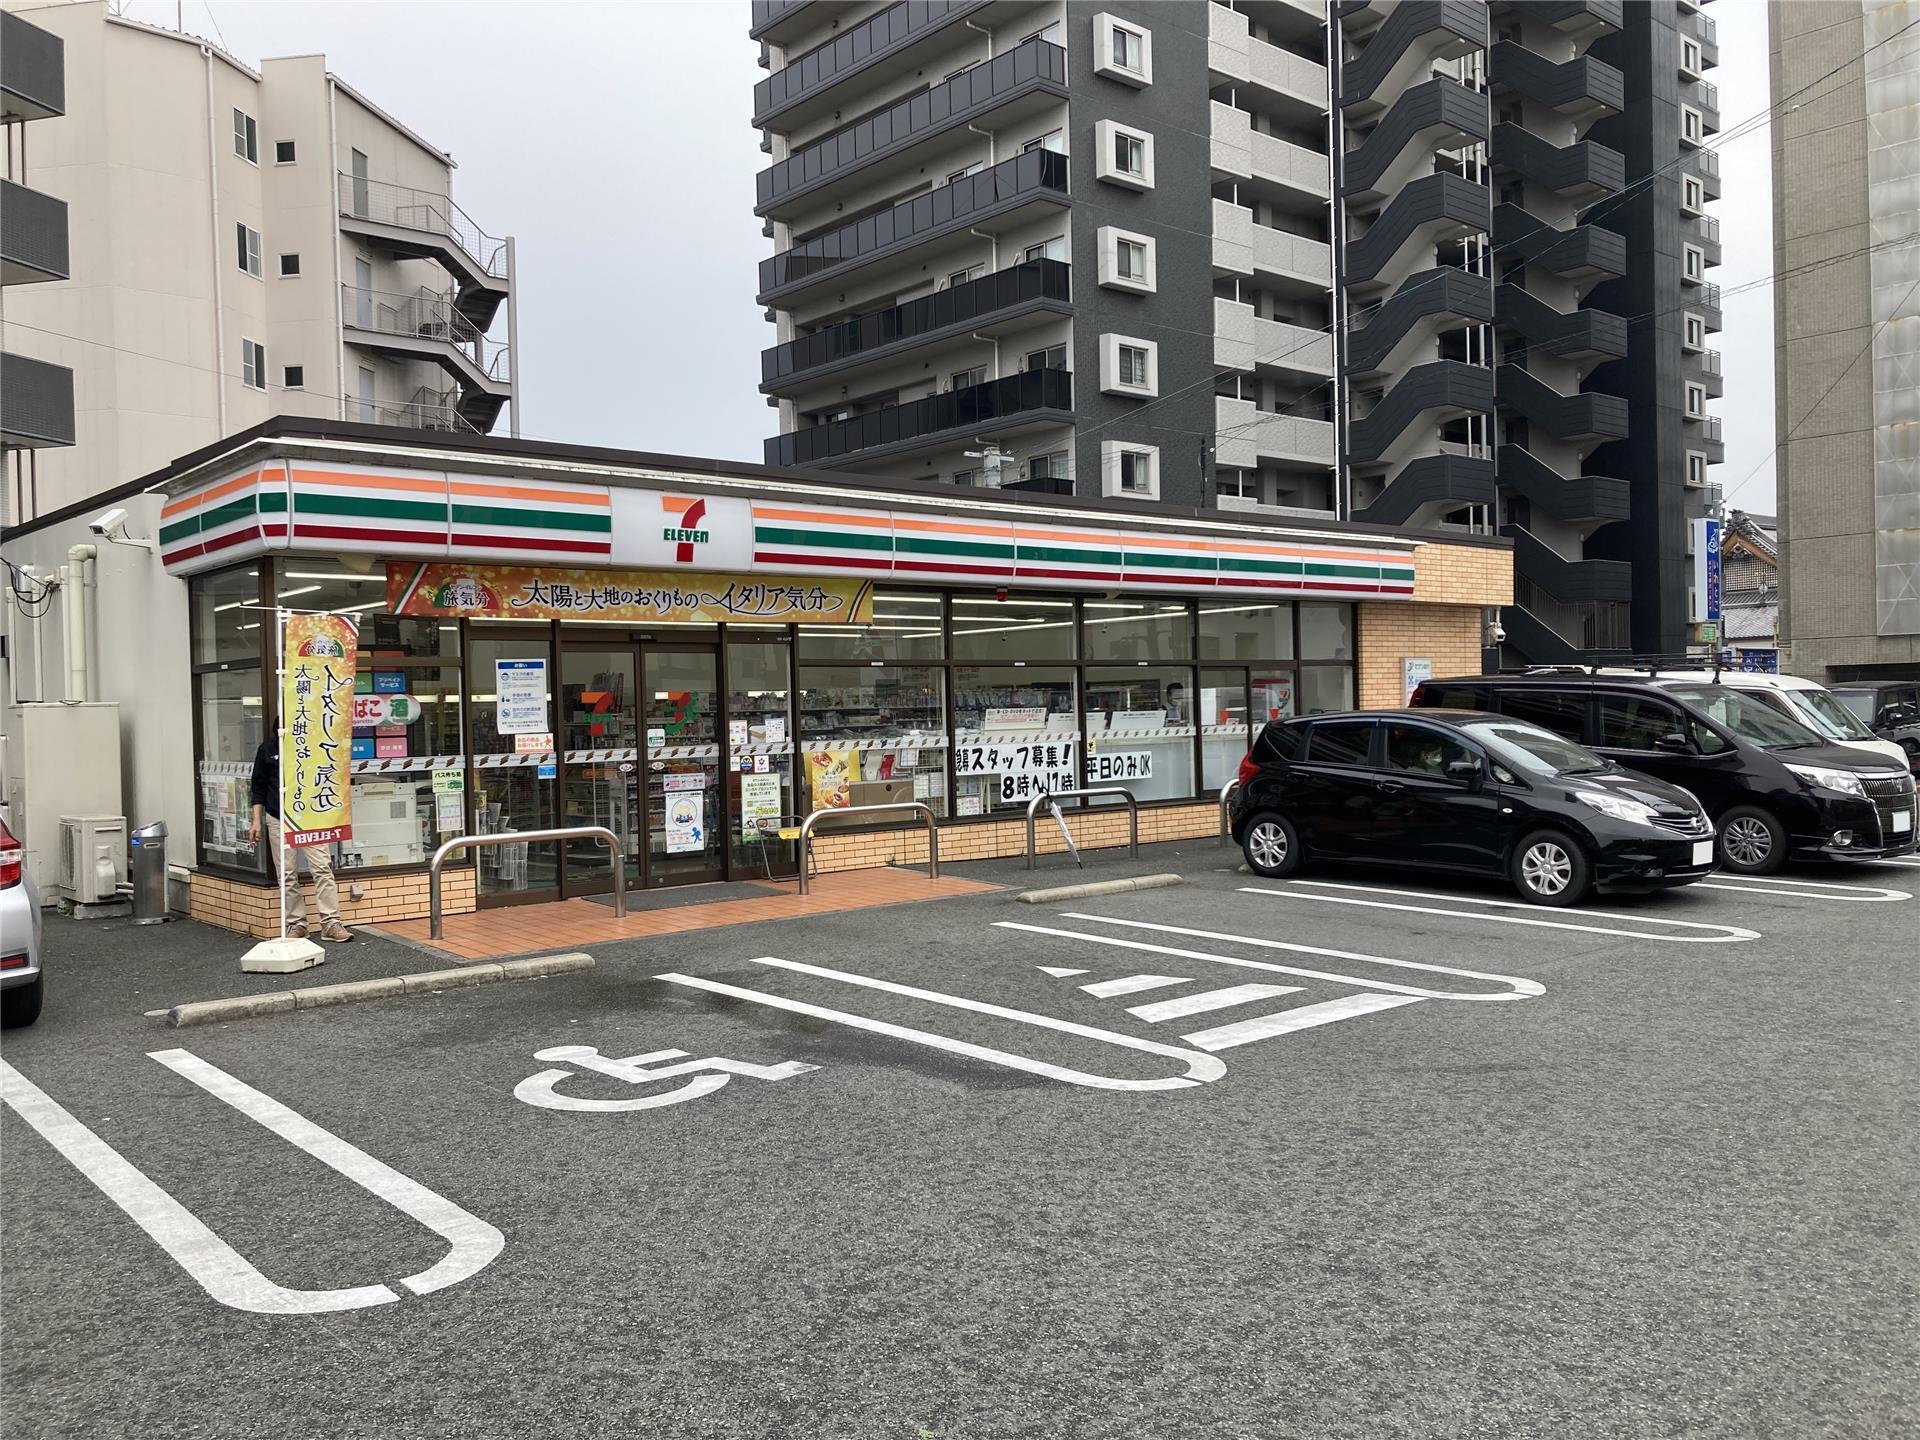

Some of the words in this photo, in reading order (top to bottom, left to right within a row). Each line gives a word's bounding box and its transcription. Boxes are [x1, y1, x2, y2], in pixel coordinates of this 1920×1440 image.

[443, 591, 489, 607] 旅気分
[511, 579, 699, 614] 太陽と大地のおくりもの
[701, 582, 843, 616] イタリア気分
[354, 699, 382, 718] ばこ
[390, 699, 409, 718] 酒
